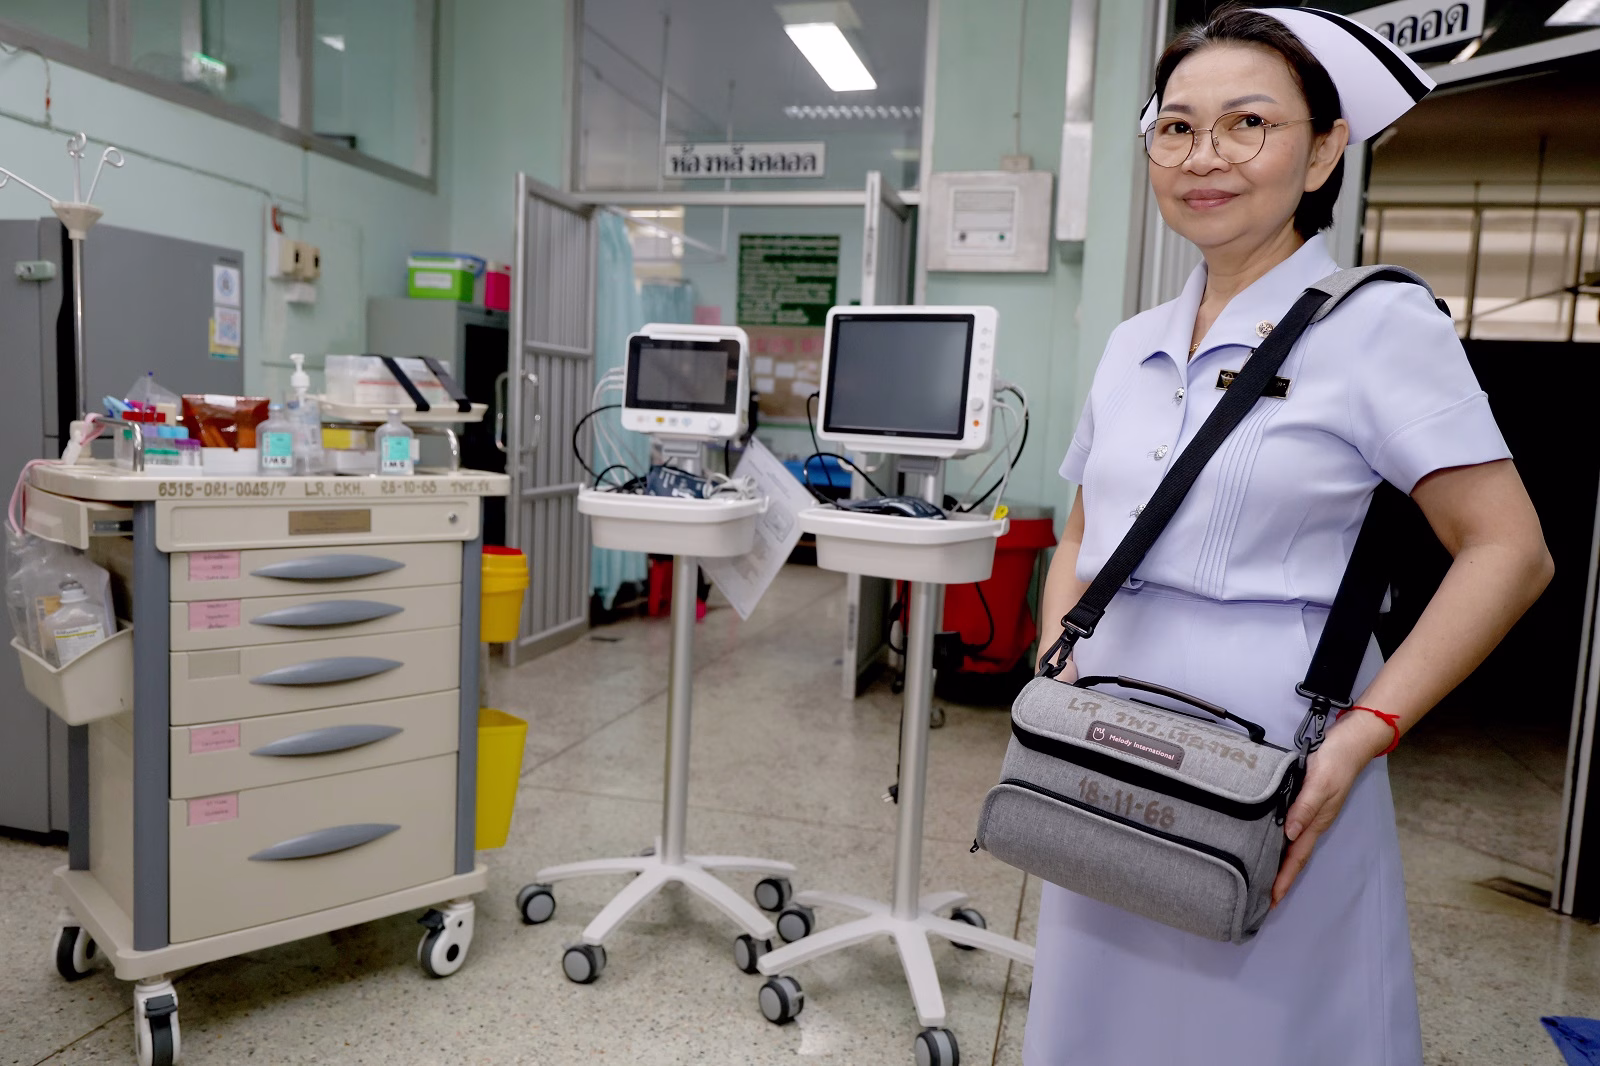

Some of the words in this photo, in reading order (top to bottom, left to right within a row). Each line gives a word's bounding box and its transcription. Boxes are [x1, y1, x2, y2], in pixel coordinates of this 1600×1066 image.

[671, 144, 817, 173] ห้องหลังคลอด
[1067, 697, 1103, 718] LR
[1109, 734, 1133, 747] Melody
[1133, 741, 1175, 760] International
[1079, 776, 1175, 829] 18-11-68
